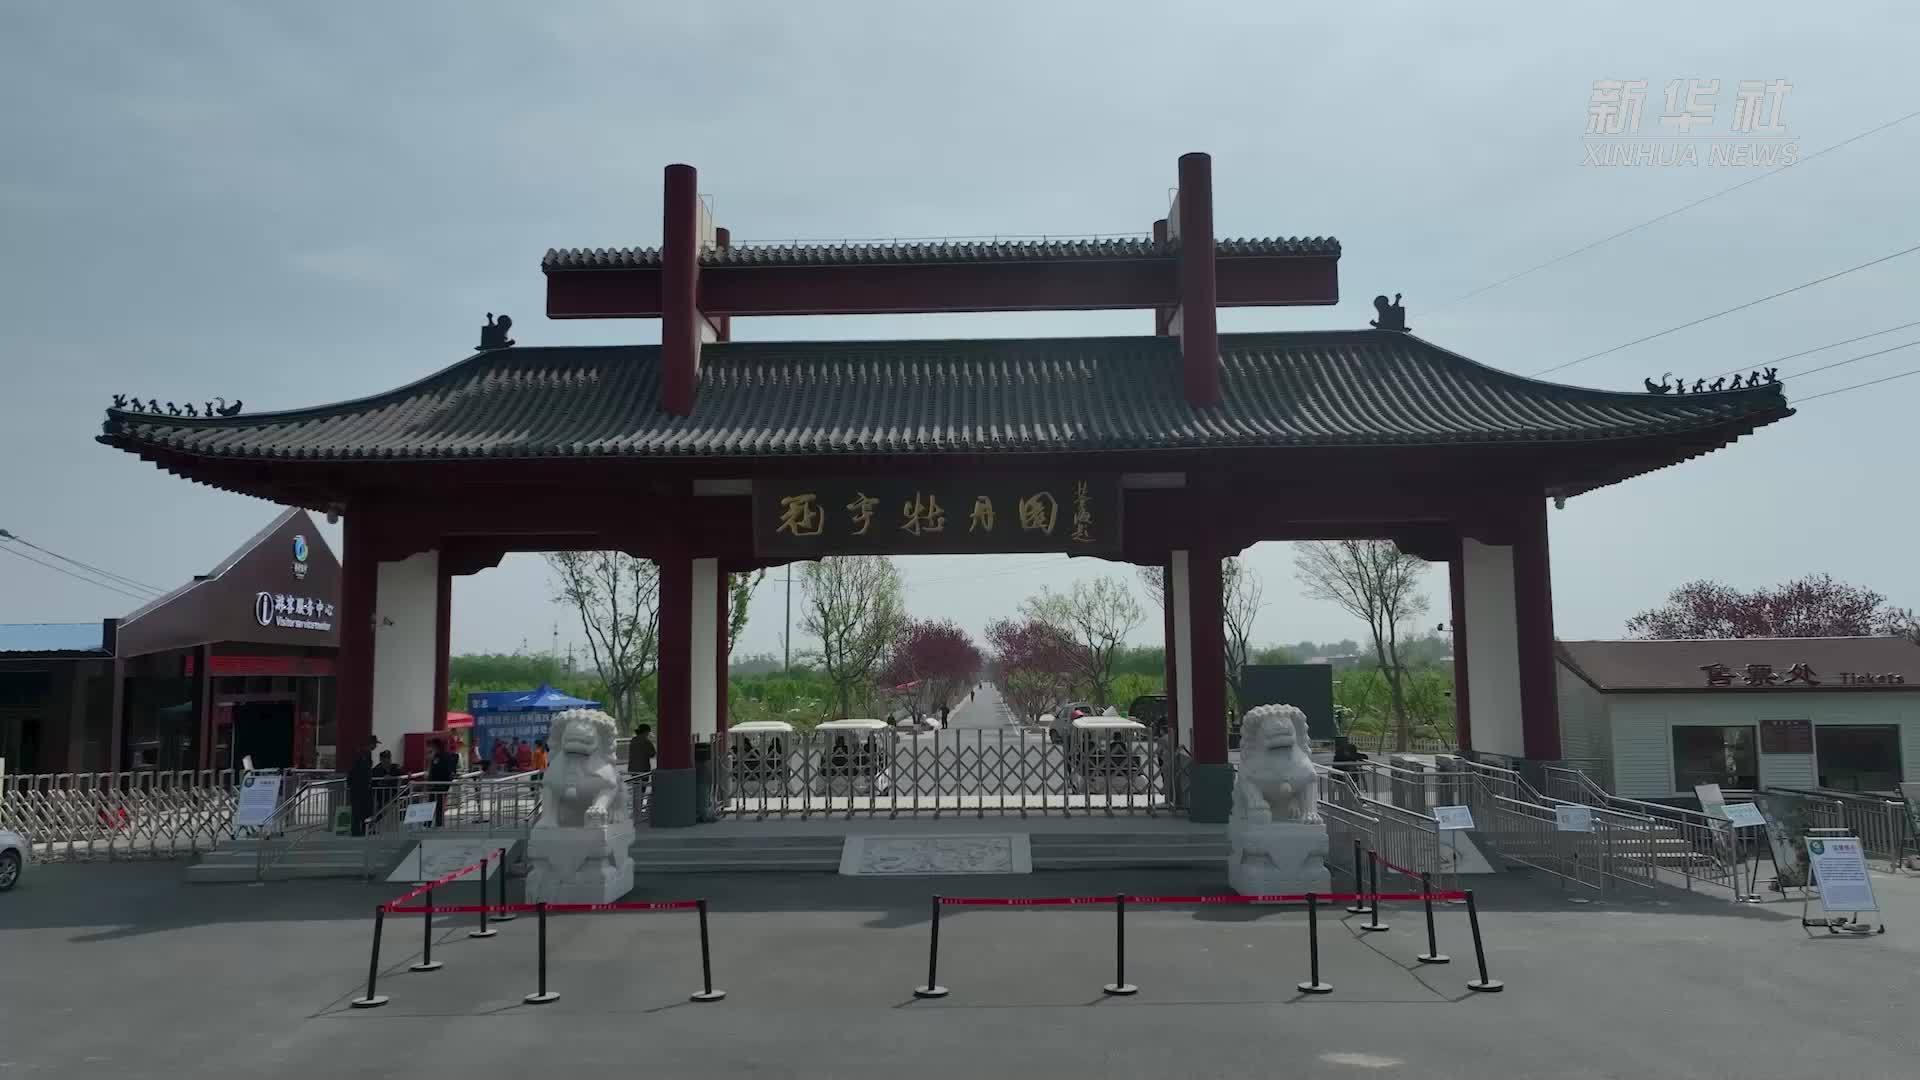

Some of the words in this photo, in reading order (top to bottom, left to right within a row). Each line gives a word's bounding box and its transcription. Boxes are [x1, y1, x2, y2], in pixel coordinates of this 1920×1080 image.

[274, 594, 335, 618] 游客服务中心
[1698, 662, 1822, 688] 售票处
[1839, 672, 1905, 685] Tickets
